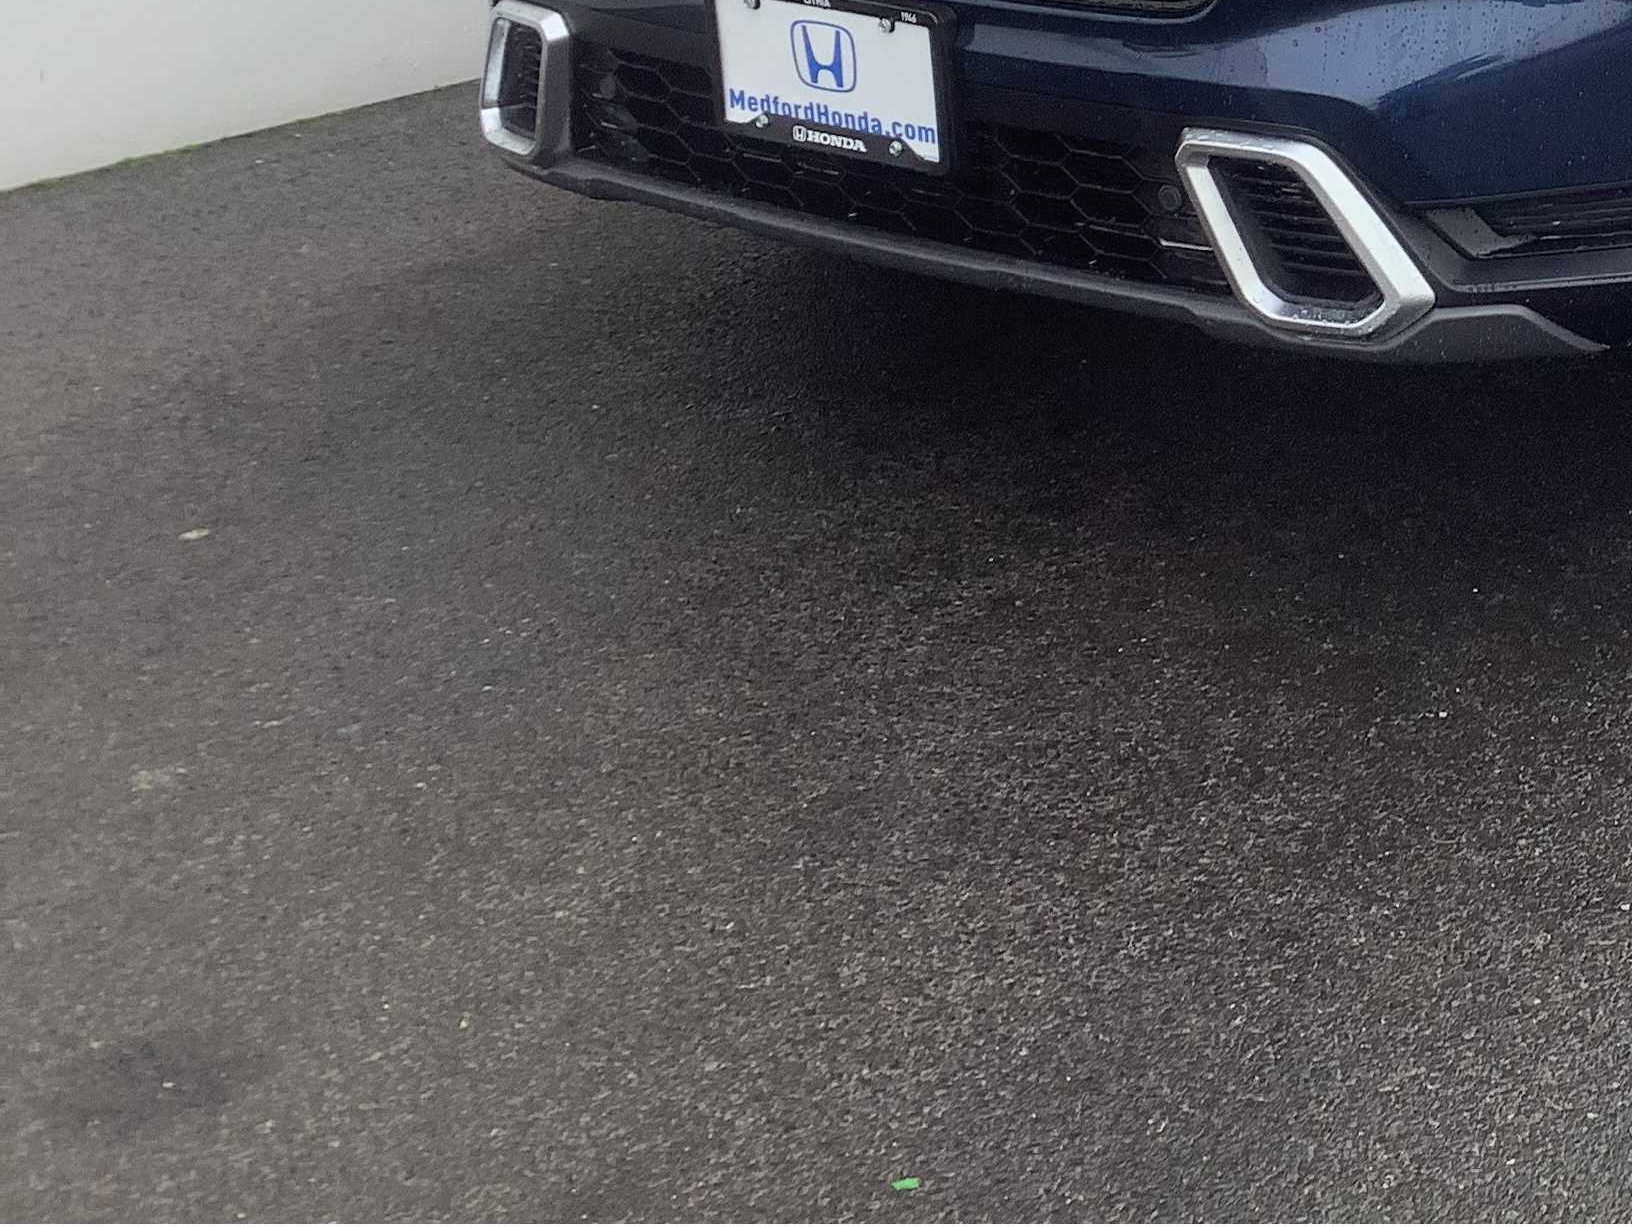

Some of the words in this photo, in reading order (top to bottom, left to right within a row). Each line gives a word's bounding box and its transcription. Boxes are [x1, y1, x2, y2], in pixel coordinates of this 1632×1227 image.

[900, 12, 917, 23] 1946
[729, 87, 936, 144] MedfordHonda.com
[807, 129, 867, 153] HONDA
